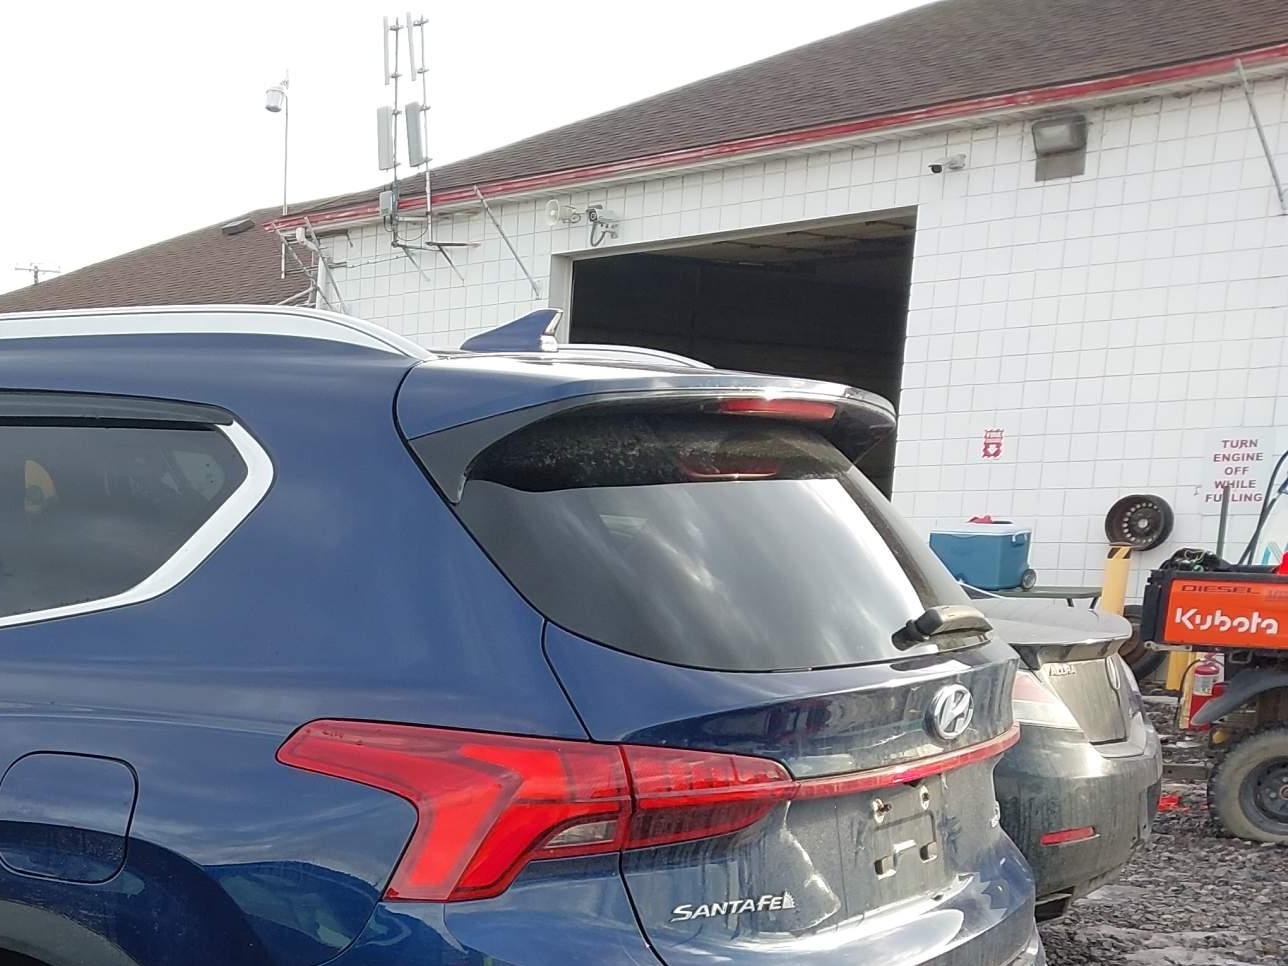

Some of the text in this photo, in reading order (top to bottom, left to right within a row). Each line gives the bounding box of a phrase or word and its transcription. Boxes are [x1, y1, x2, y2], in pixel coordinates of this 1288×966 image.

[1221, 439, 1258, 448] TURN
[1213, 452, 1264, 462] ENGINE
[1224, 466, 1249, 475] OFF
[1214, 479, 1257, 488] WHILE
[1205, 493, 1263, 502] FULING
[1175, 607, 1279, 635] Kubota
